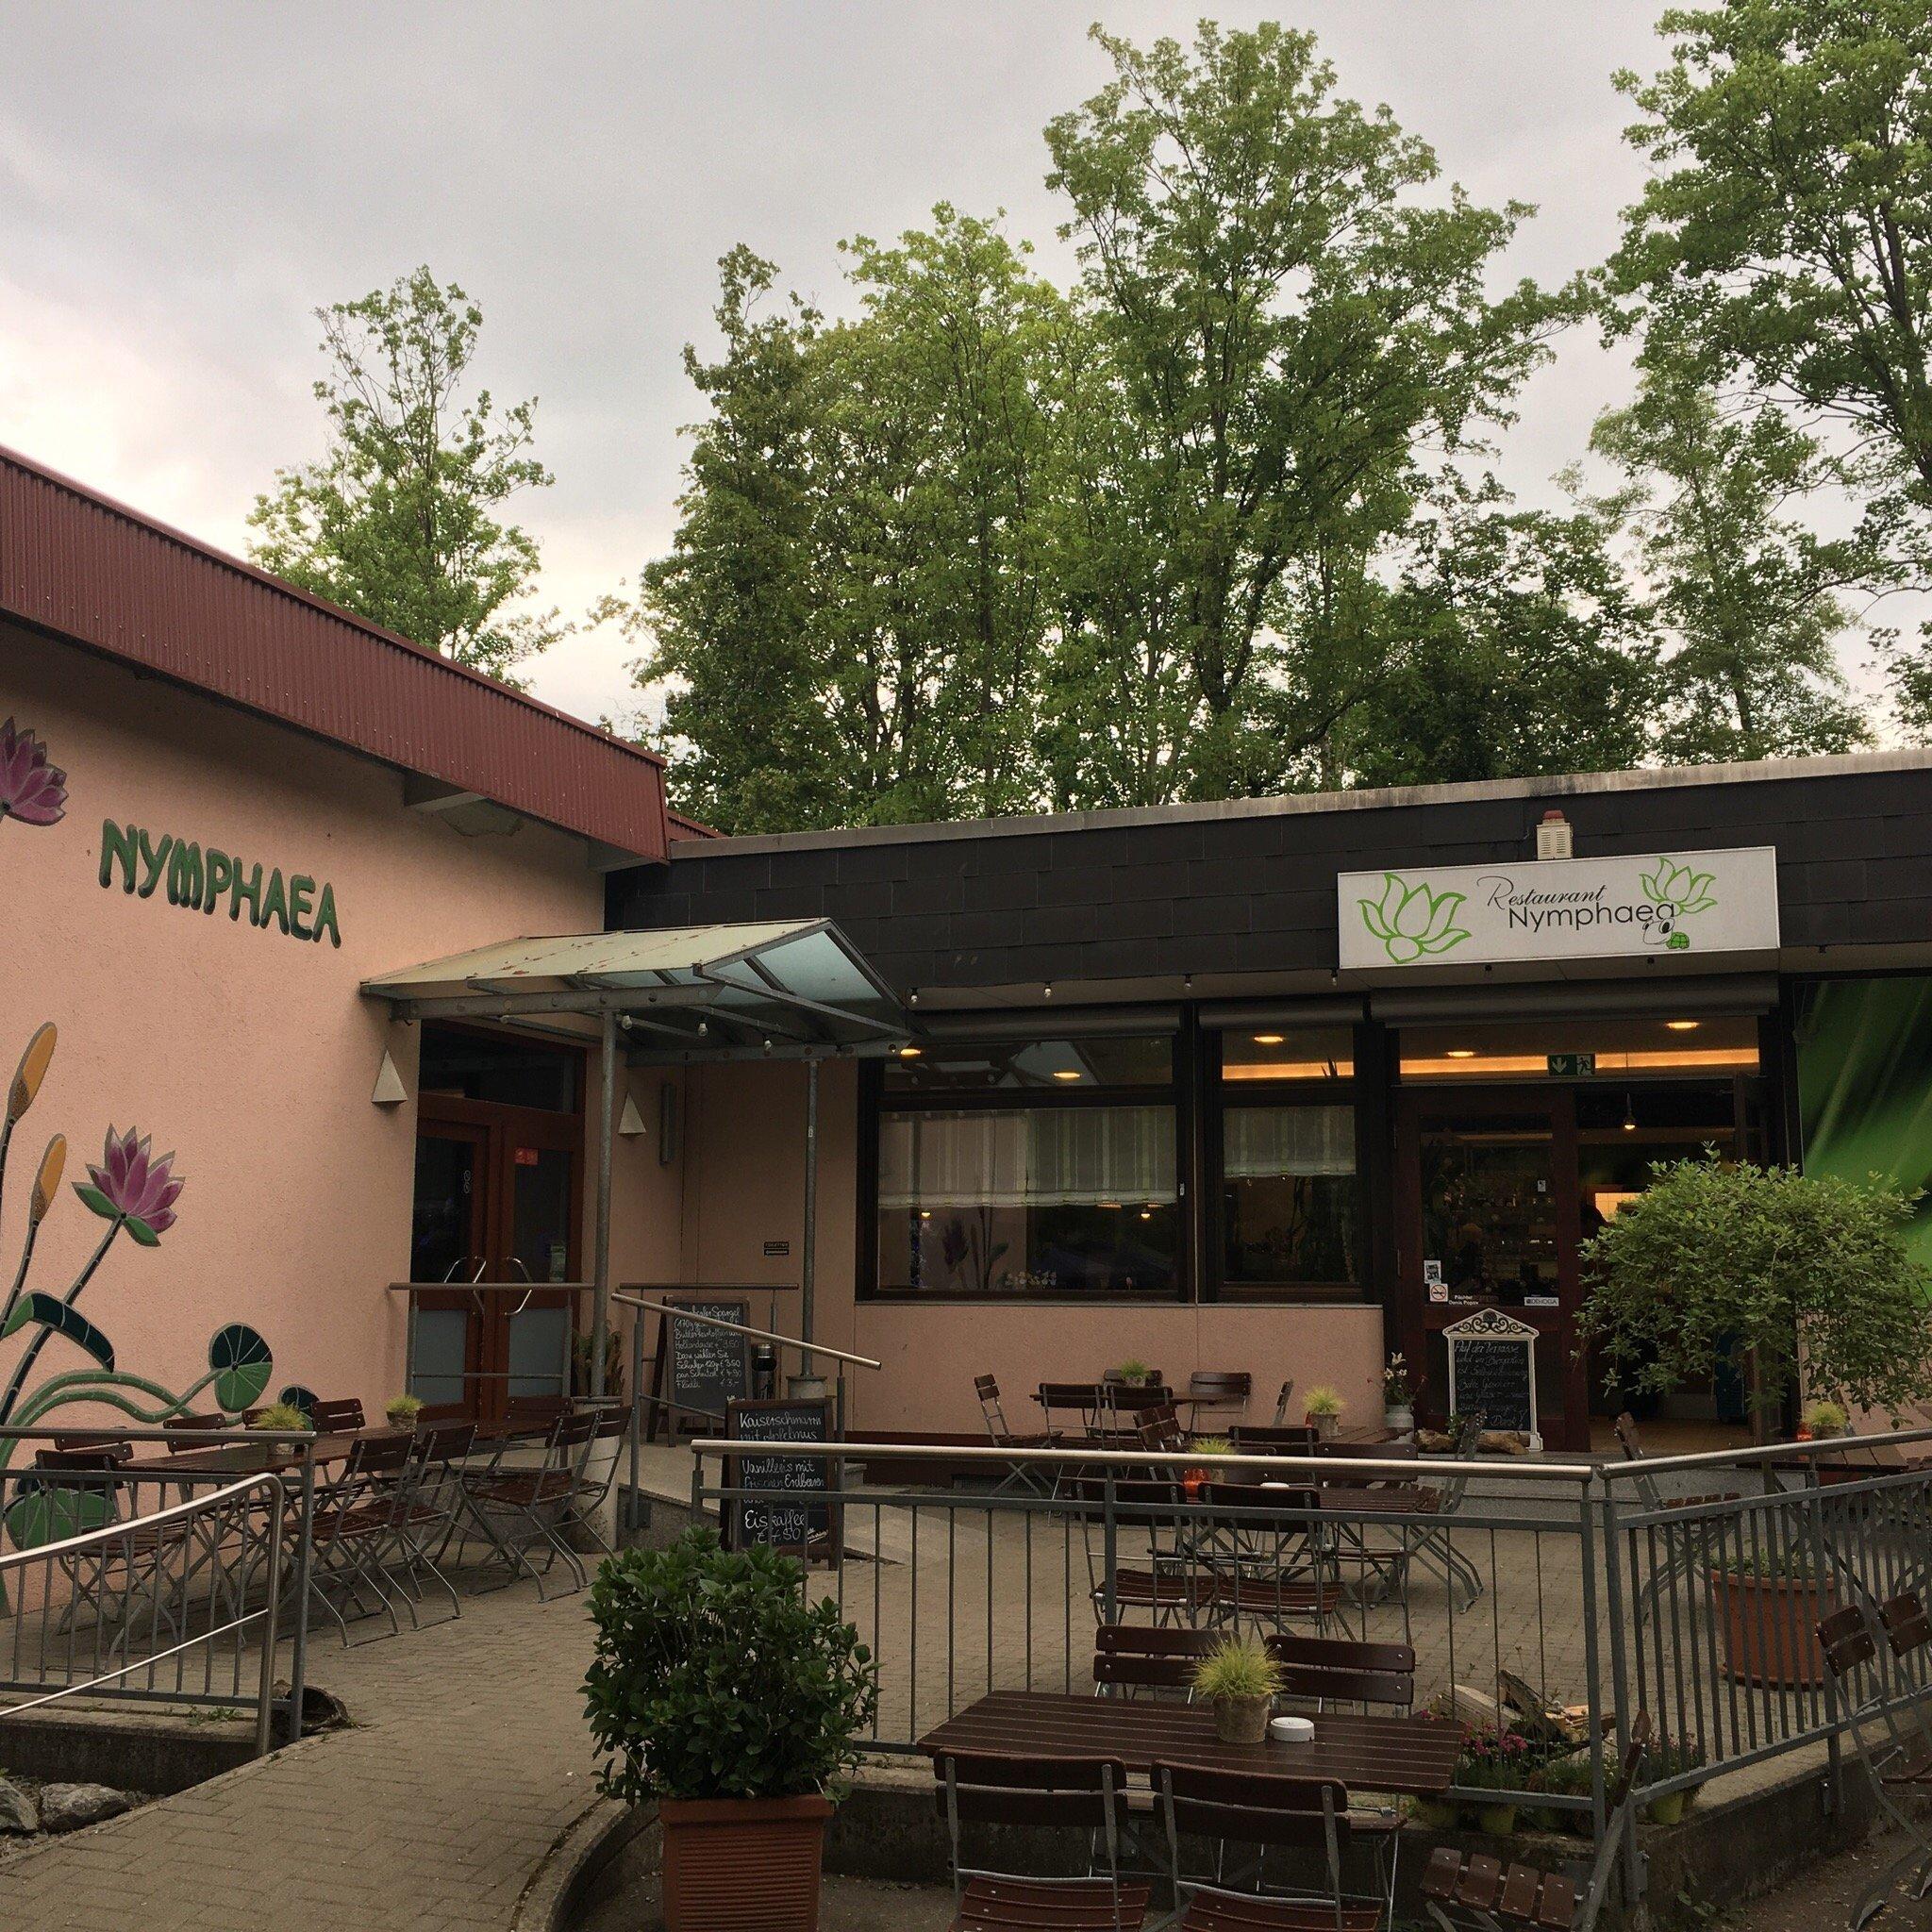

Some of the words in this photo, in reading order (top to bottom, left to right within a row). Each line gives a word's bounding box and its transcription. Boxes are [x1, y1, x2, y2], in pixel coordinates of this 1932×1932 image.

[98, 818, 341, 949] NYMPHAEA
[1476, 874, 1607, 910] Restaurant
[1508, 901, 1675, 932] Nymphaea
[795, 1459, 815, 1474] mit
